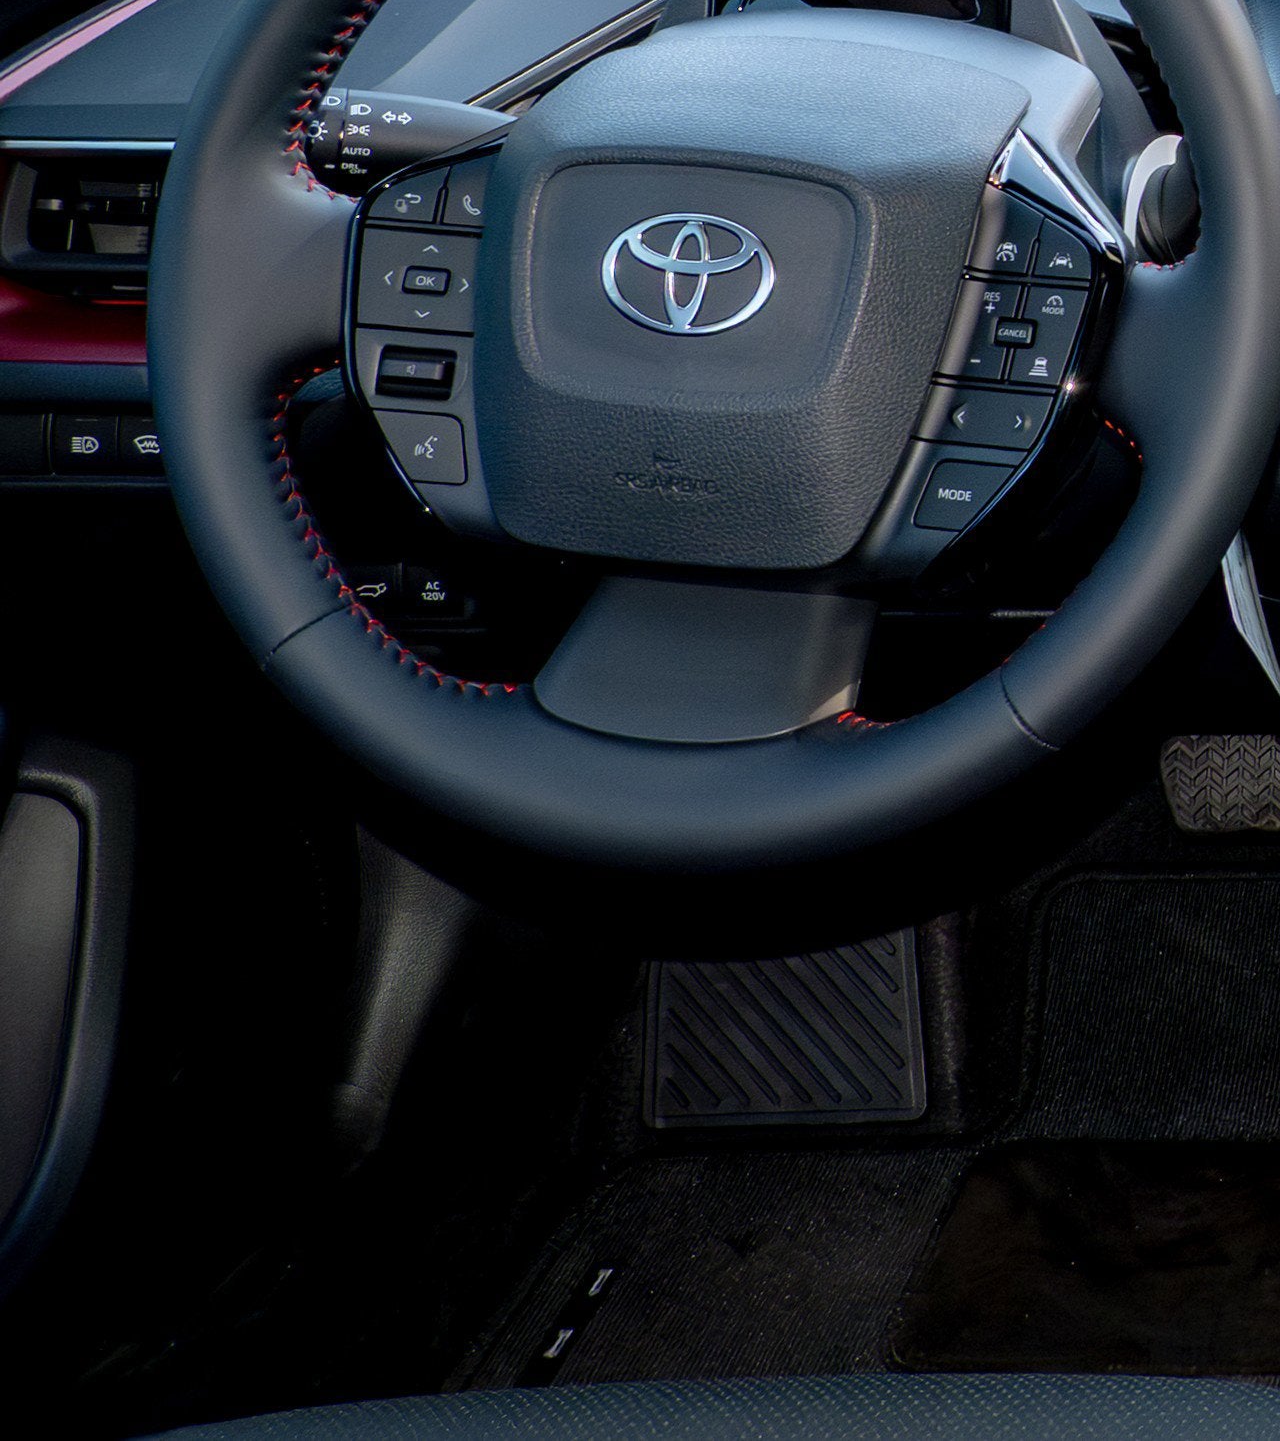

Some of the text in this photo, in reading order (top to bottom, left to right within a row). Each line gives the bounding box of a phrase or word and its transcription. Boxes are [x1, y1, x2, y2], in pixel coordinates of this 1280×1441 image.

[342, 147, 371, 157] AUTO
[415, 275, 437, 287] OK
[983, 291, 1001, 302] RES
[1041, 306, 1065, 316] MODE
[997, 328, 1028, 339] CANCEL
[937, 488, 973, 502] MODE
[425, 581, 440, 590] AC
[421, 592, 446, 601] 120V
